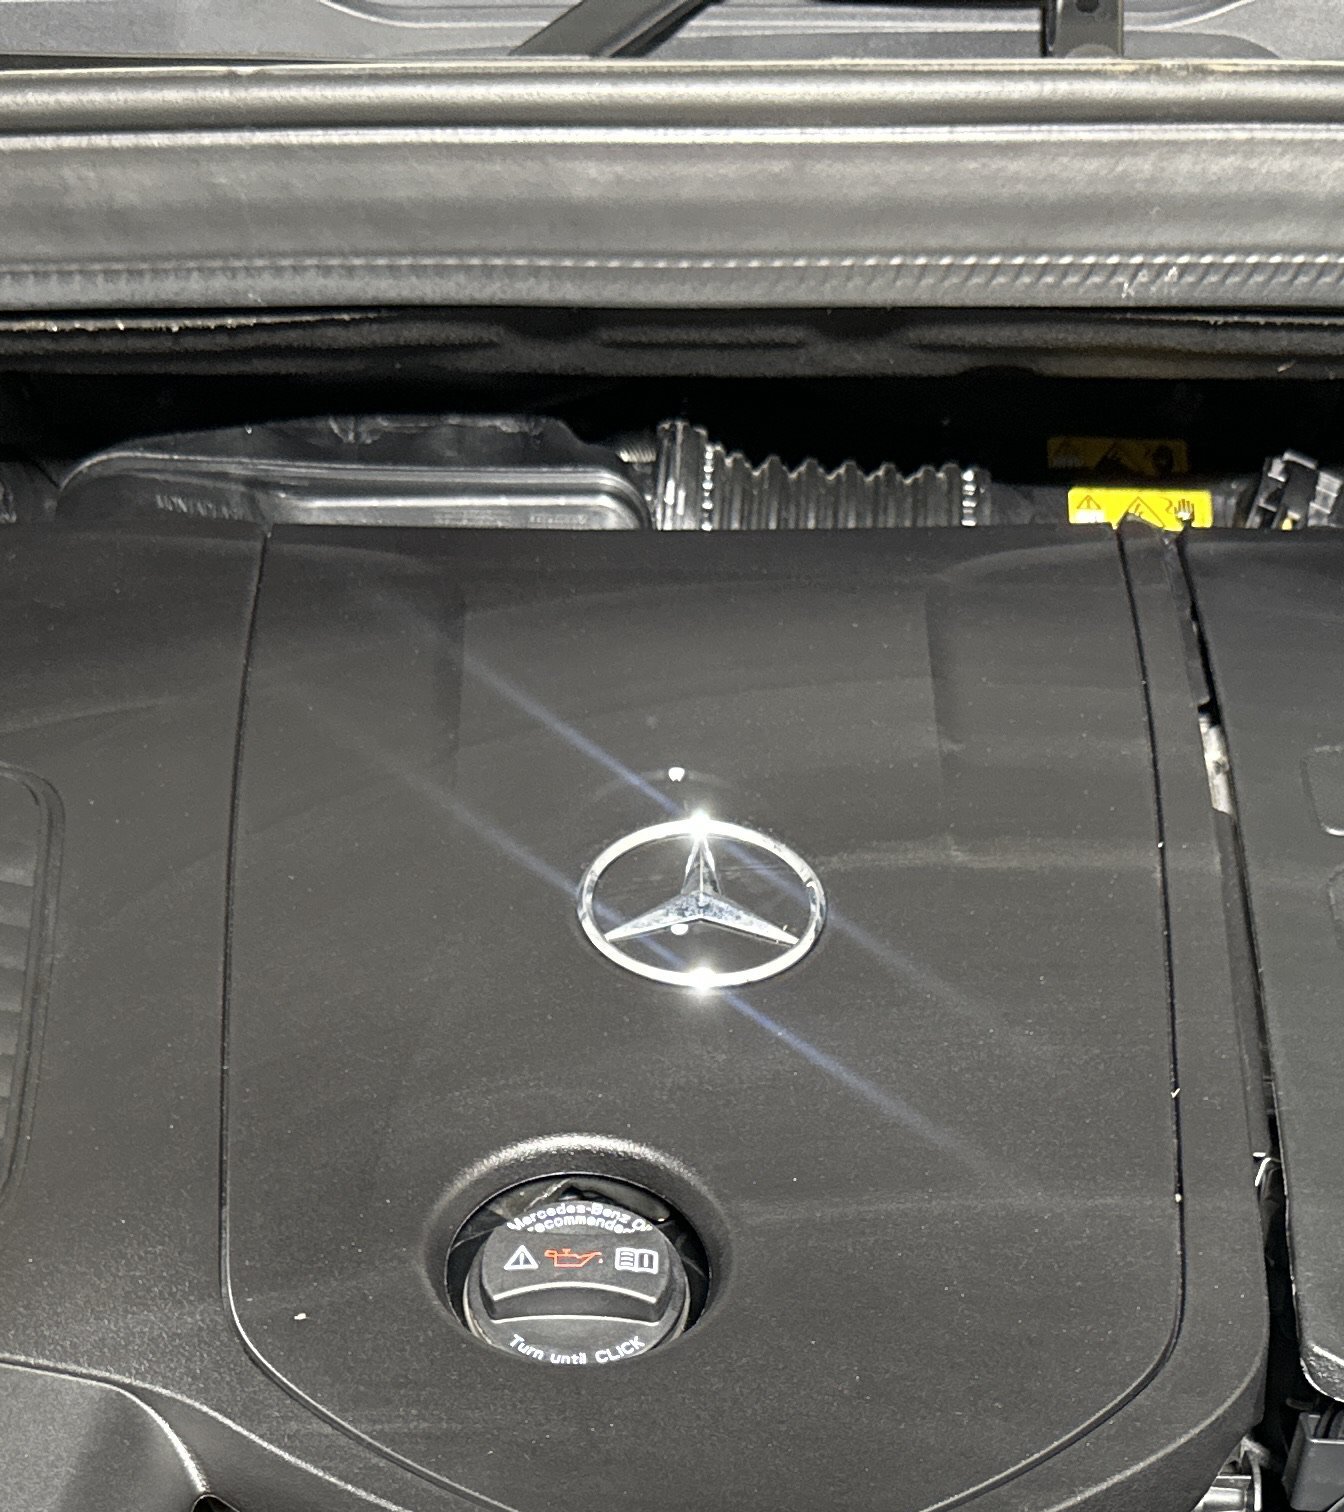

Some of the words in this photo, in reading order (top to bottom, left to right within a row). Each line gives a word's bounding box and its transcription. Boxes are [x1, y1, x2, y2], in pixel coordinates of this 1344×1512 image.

[509, 1333, 544, 1360] Turn
[550, 1352, 587, 1365] until
[594, 1335, 645, 1364] CLICK
